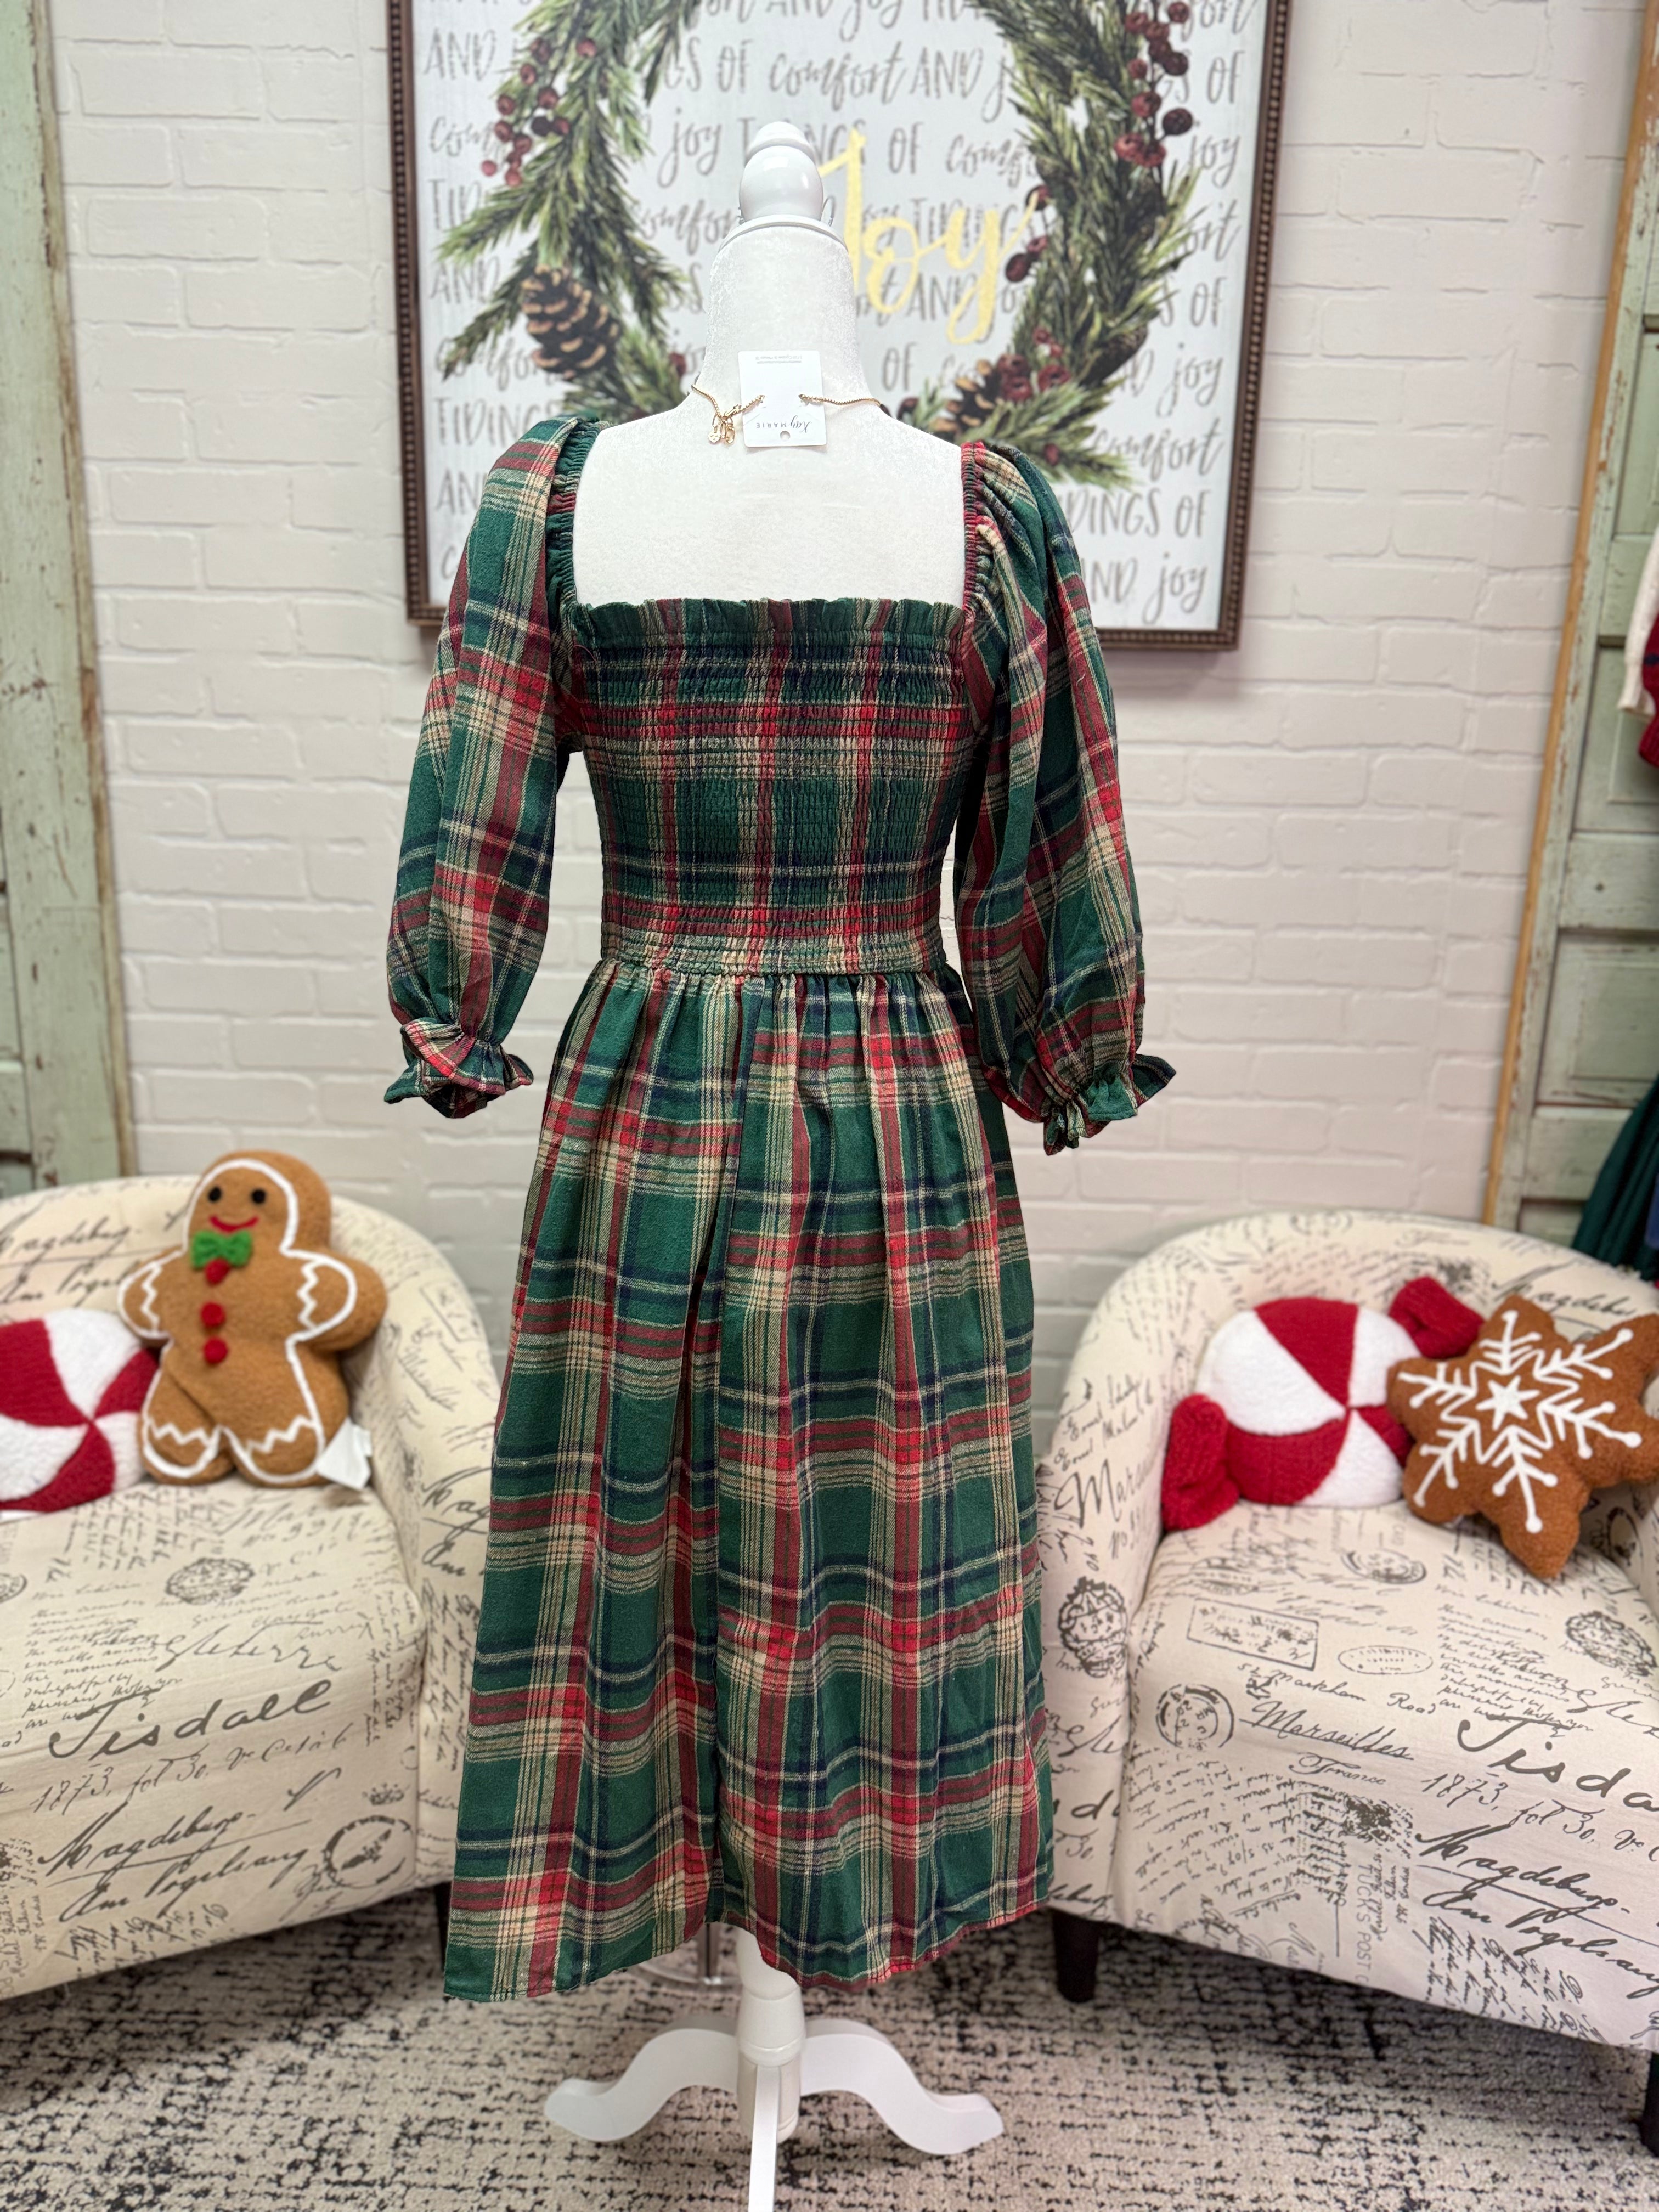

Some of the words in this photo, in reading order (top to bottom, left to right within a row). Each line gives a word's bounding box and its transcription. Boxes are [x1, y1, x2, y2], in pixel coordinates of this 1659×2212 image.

[424, 26, 497, 82] AND
[716, 38, 754, 94] OF
[909, 46, 984, 100] AND
[1206, 50, 1245, 104] OF
[657, 106, 722, 188] joy
[888, 122, 924, 175] OF
[817, 126, 1040, 346] Joy
[1190, 277, 1227, 328] OF
[882, 341, 918, 391] OF
[1156, 342, 1223, 418] joy
[436, 468, 488, 515] AN
[1176, 489, 1210, 538] OF
[1081, 556, 1138, 603] ND
[1142, 552, 1208, 625] joy
[1356, 1931, 1372, 1971] POST
